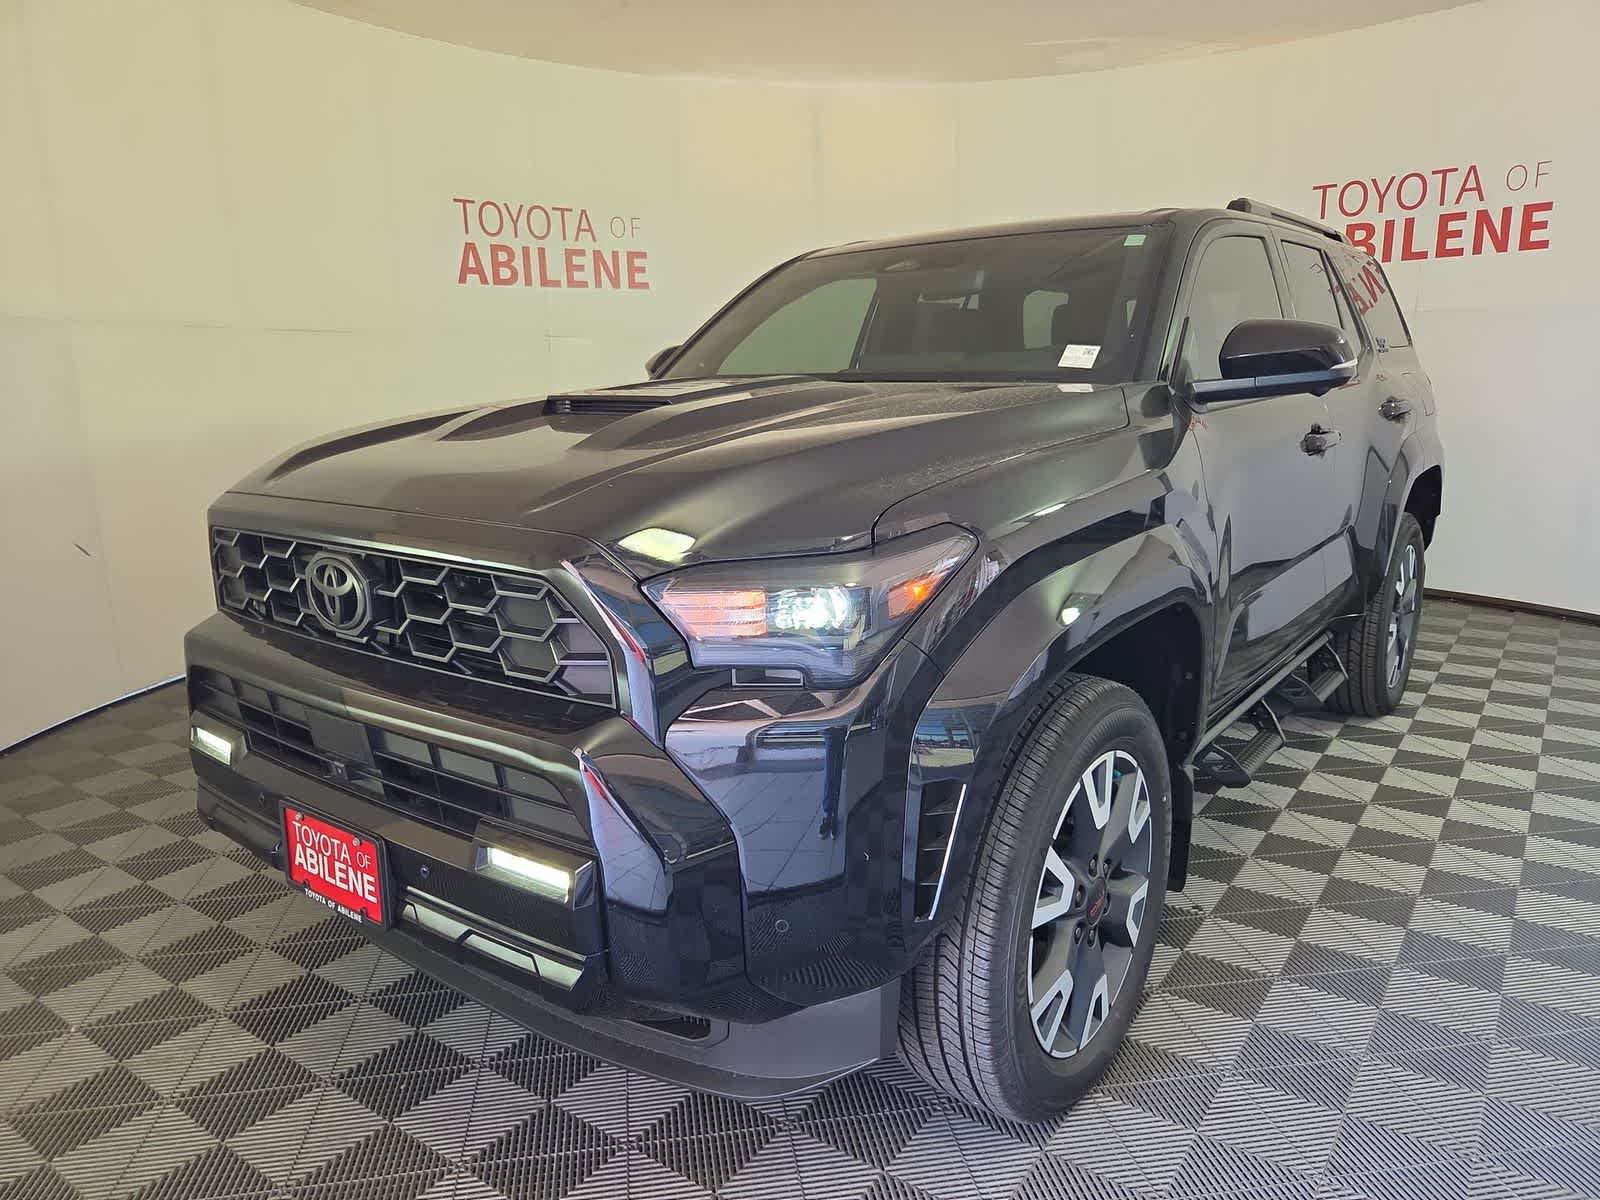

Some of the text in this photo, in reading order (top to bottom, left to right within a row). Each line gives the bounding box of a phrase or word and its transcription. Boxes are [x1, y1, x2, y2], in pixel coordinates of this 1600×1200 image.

[1312, 160, 1552, 220] TOYOTA OF
[453, 198, 640, 242] TOYOTA OF
[1345, 201, 1554, 263] BILENE
[458, 242, 650, 289] ABILENE
[292, 820, 371, 869] TOYOTA OF
[295, 843, 378, 904] ABILENE
[305, 888, 362, 923] TOYOTA OF ABILENE
